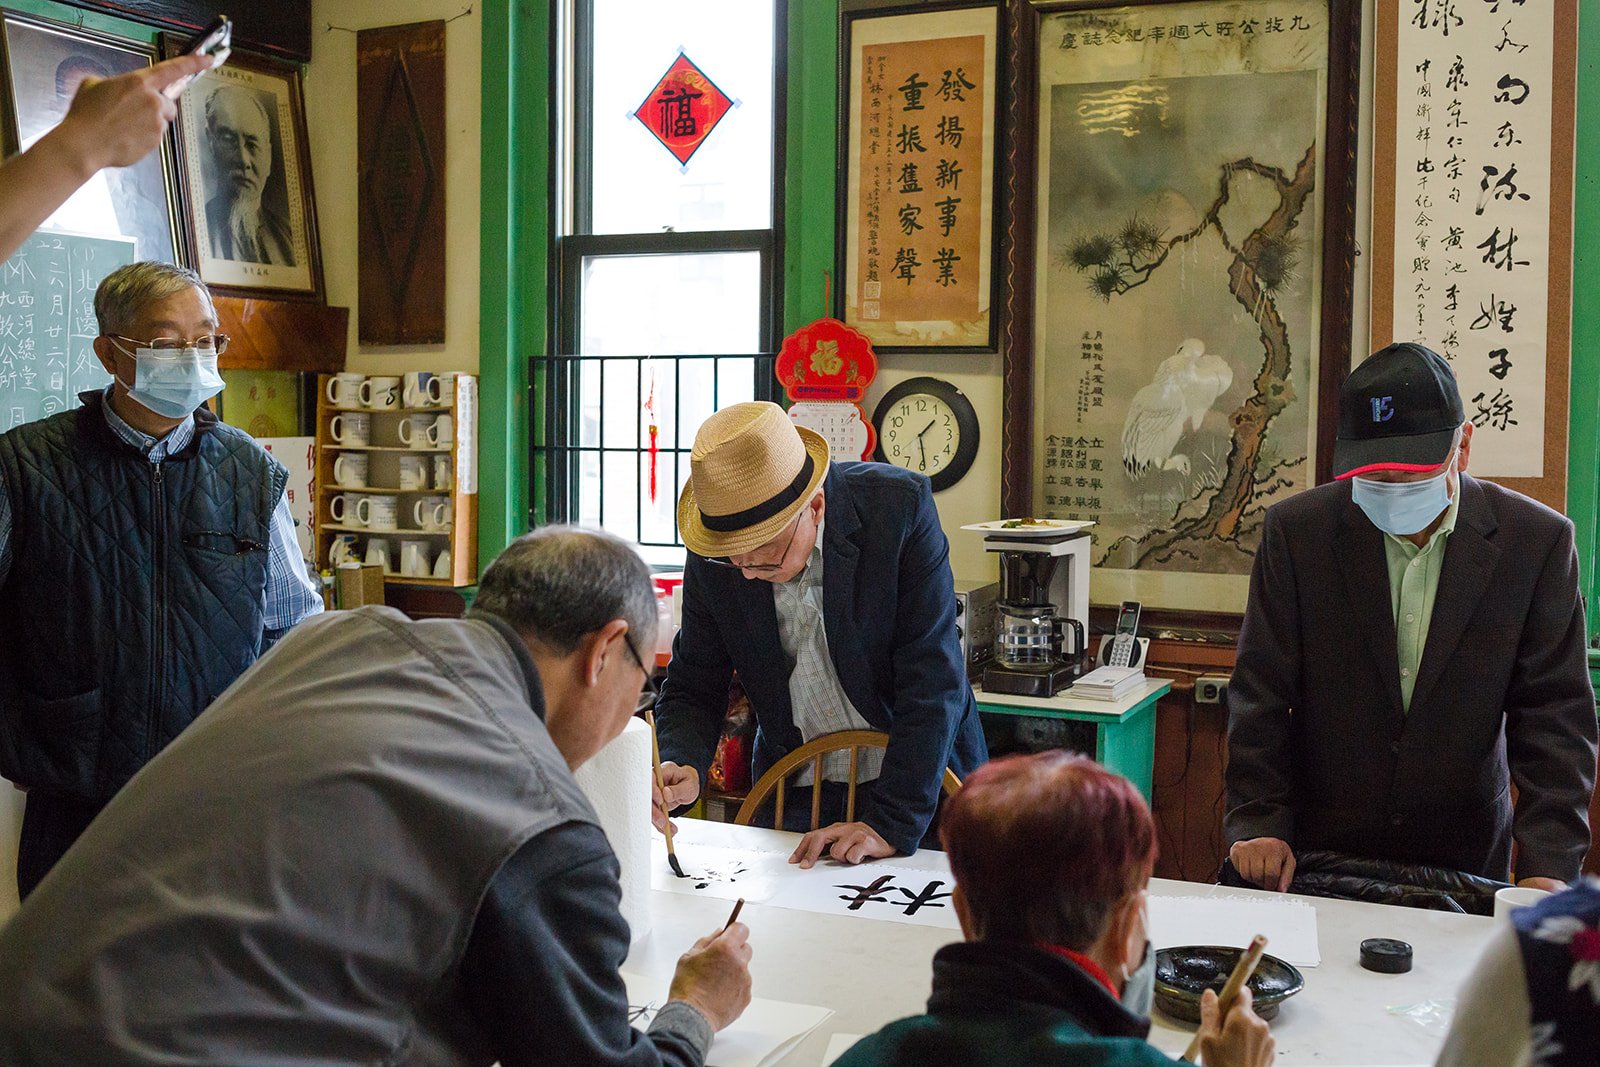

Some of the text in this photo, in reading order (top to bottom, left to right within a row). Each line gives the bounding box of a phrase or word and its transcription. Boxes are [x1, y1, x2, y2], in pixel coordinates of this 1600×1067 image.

[657, 87, 704, 139] 福
[932, 67, 976, 288] 發揚新事業
[17, 290, 40, 392] 西河總堂
[810, 339, 844, 377] 福
[901, 405, 910, 416] 11
[915, 400, 927, 412] 12
[932, 404, 938, 415] 1
[891, 416, 904, 427] 10
[943, 415, 951, 426] 2
[889, 430, 897, 441] 9
[946, 429, 953, 441] 3
[892, 445, 901, 457] 8
[942, 444, 951, 455] 4
[904, 456, 911, 467] 7
[932, 456, 939, 467] 5
